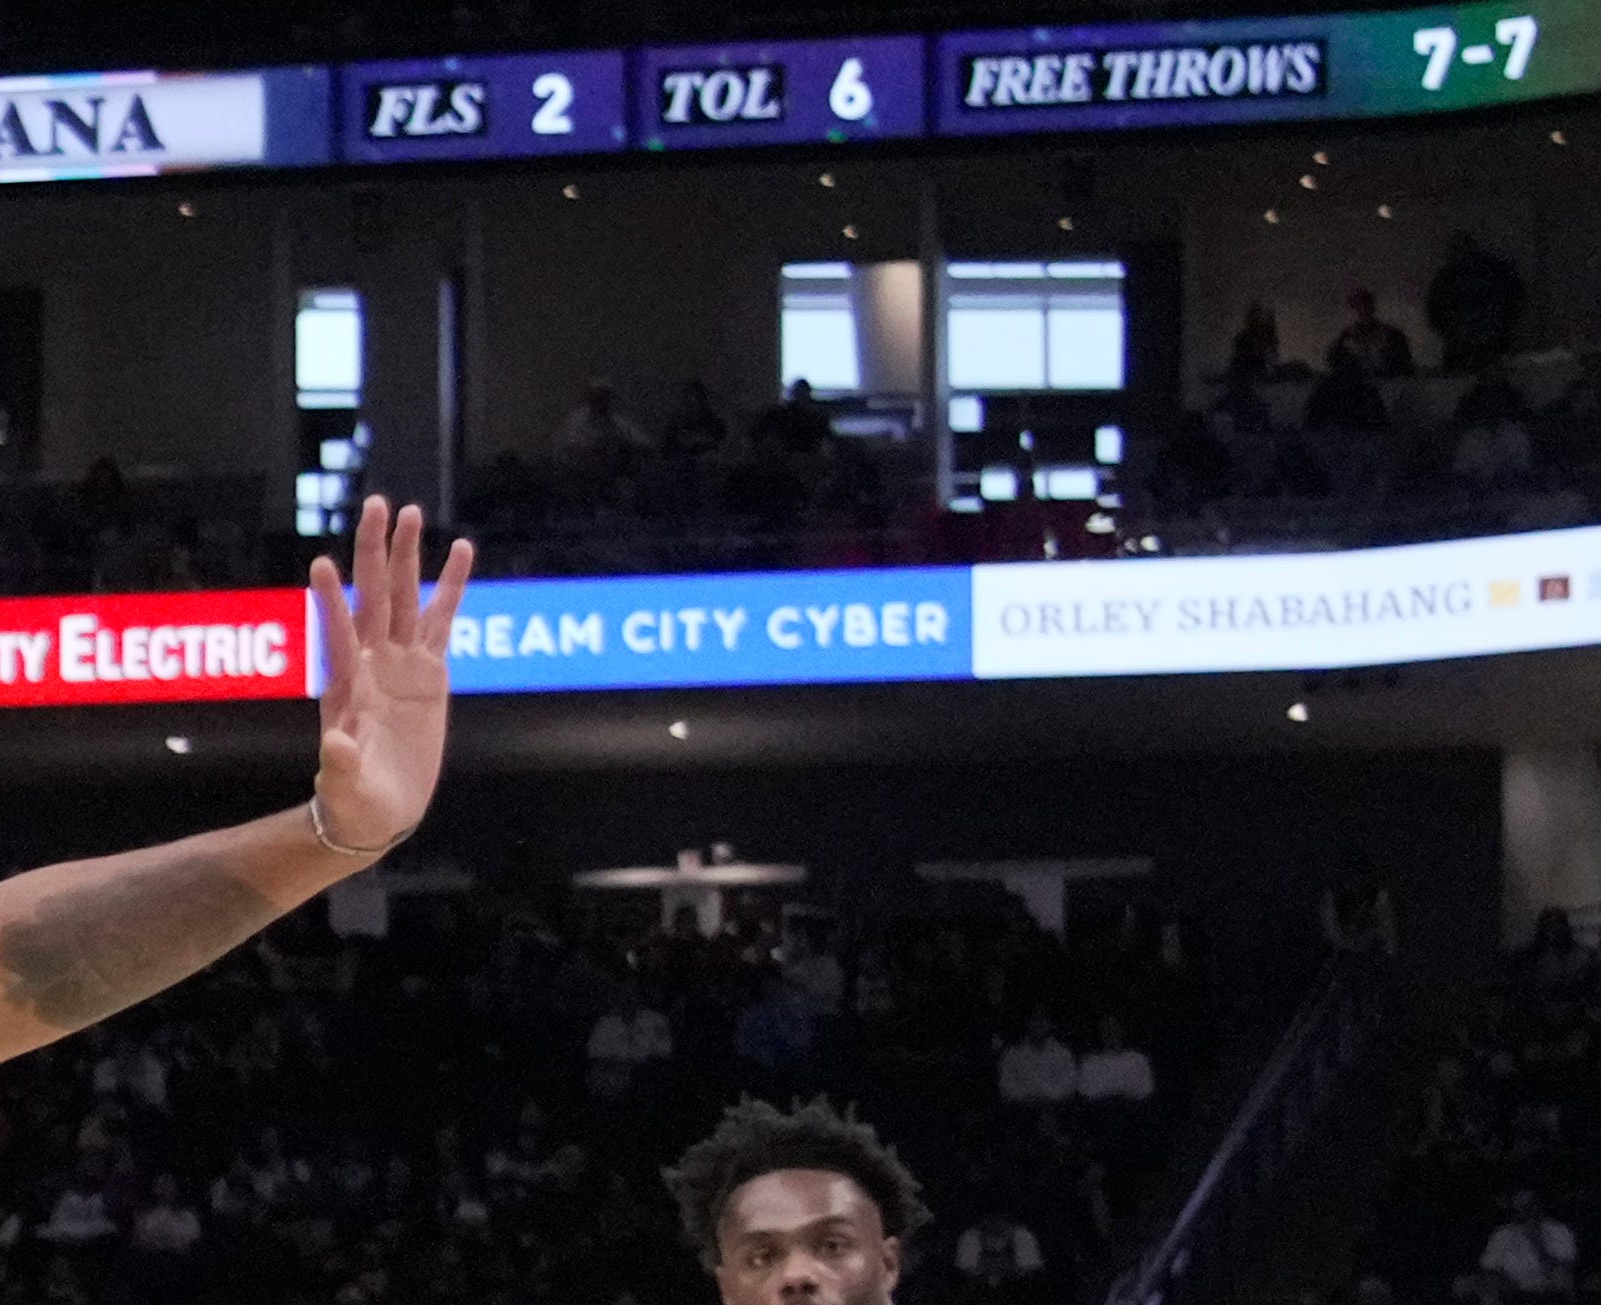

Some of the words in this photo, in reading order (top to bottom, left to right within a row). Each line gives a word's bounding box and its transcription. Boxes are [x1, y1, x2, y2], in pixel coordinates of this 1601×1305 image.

[663, 70, 780, 122] TOL
[828, 58, 873, 121] 6
[966, 54, 1093, 107] FREE
[1102, 43, 1321, 100] THROWS
[1412, 15, 1537, 91] 7-7
[369, 82, 485, 138] FLS
[531, 73, 574, 135] 2
[449, 612, 604, 659] REAM
[621, 607, 748, 654] CITY
[765, 601, 949, 649] CYBER
[999, 601, 1160, 640] ORLEY
[1177, 580, 1474, 633] SHABAHANG
[59, 614, 289, 683] ELECTRIC
